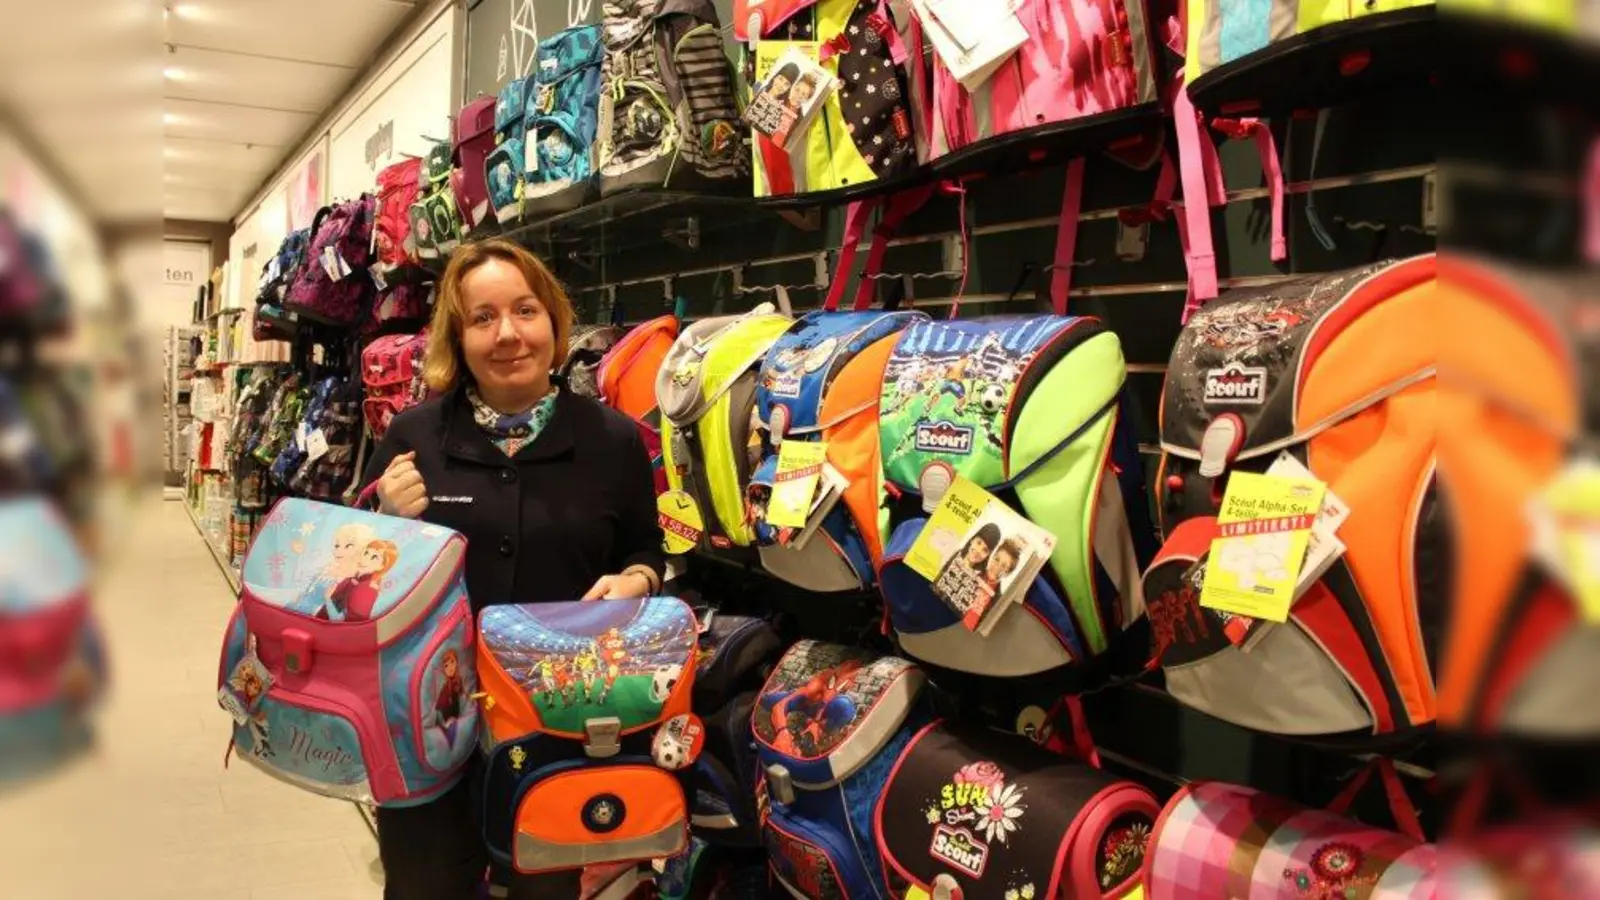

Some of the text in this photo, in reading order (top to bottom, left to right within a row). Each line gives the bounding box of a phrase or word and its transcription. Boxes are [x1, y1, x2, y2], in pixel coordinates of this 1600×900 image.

[165, 267, 194, 282] ten
[1206, 377, 1258, 397] Scout
[918, 429, 969, 449] Scout
[1228, 496, 1257, 509] Scout
[287, 724, 353, 774] Magic
[936, 833, 981, 869] Scout
